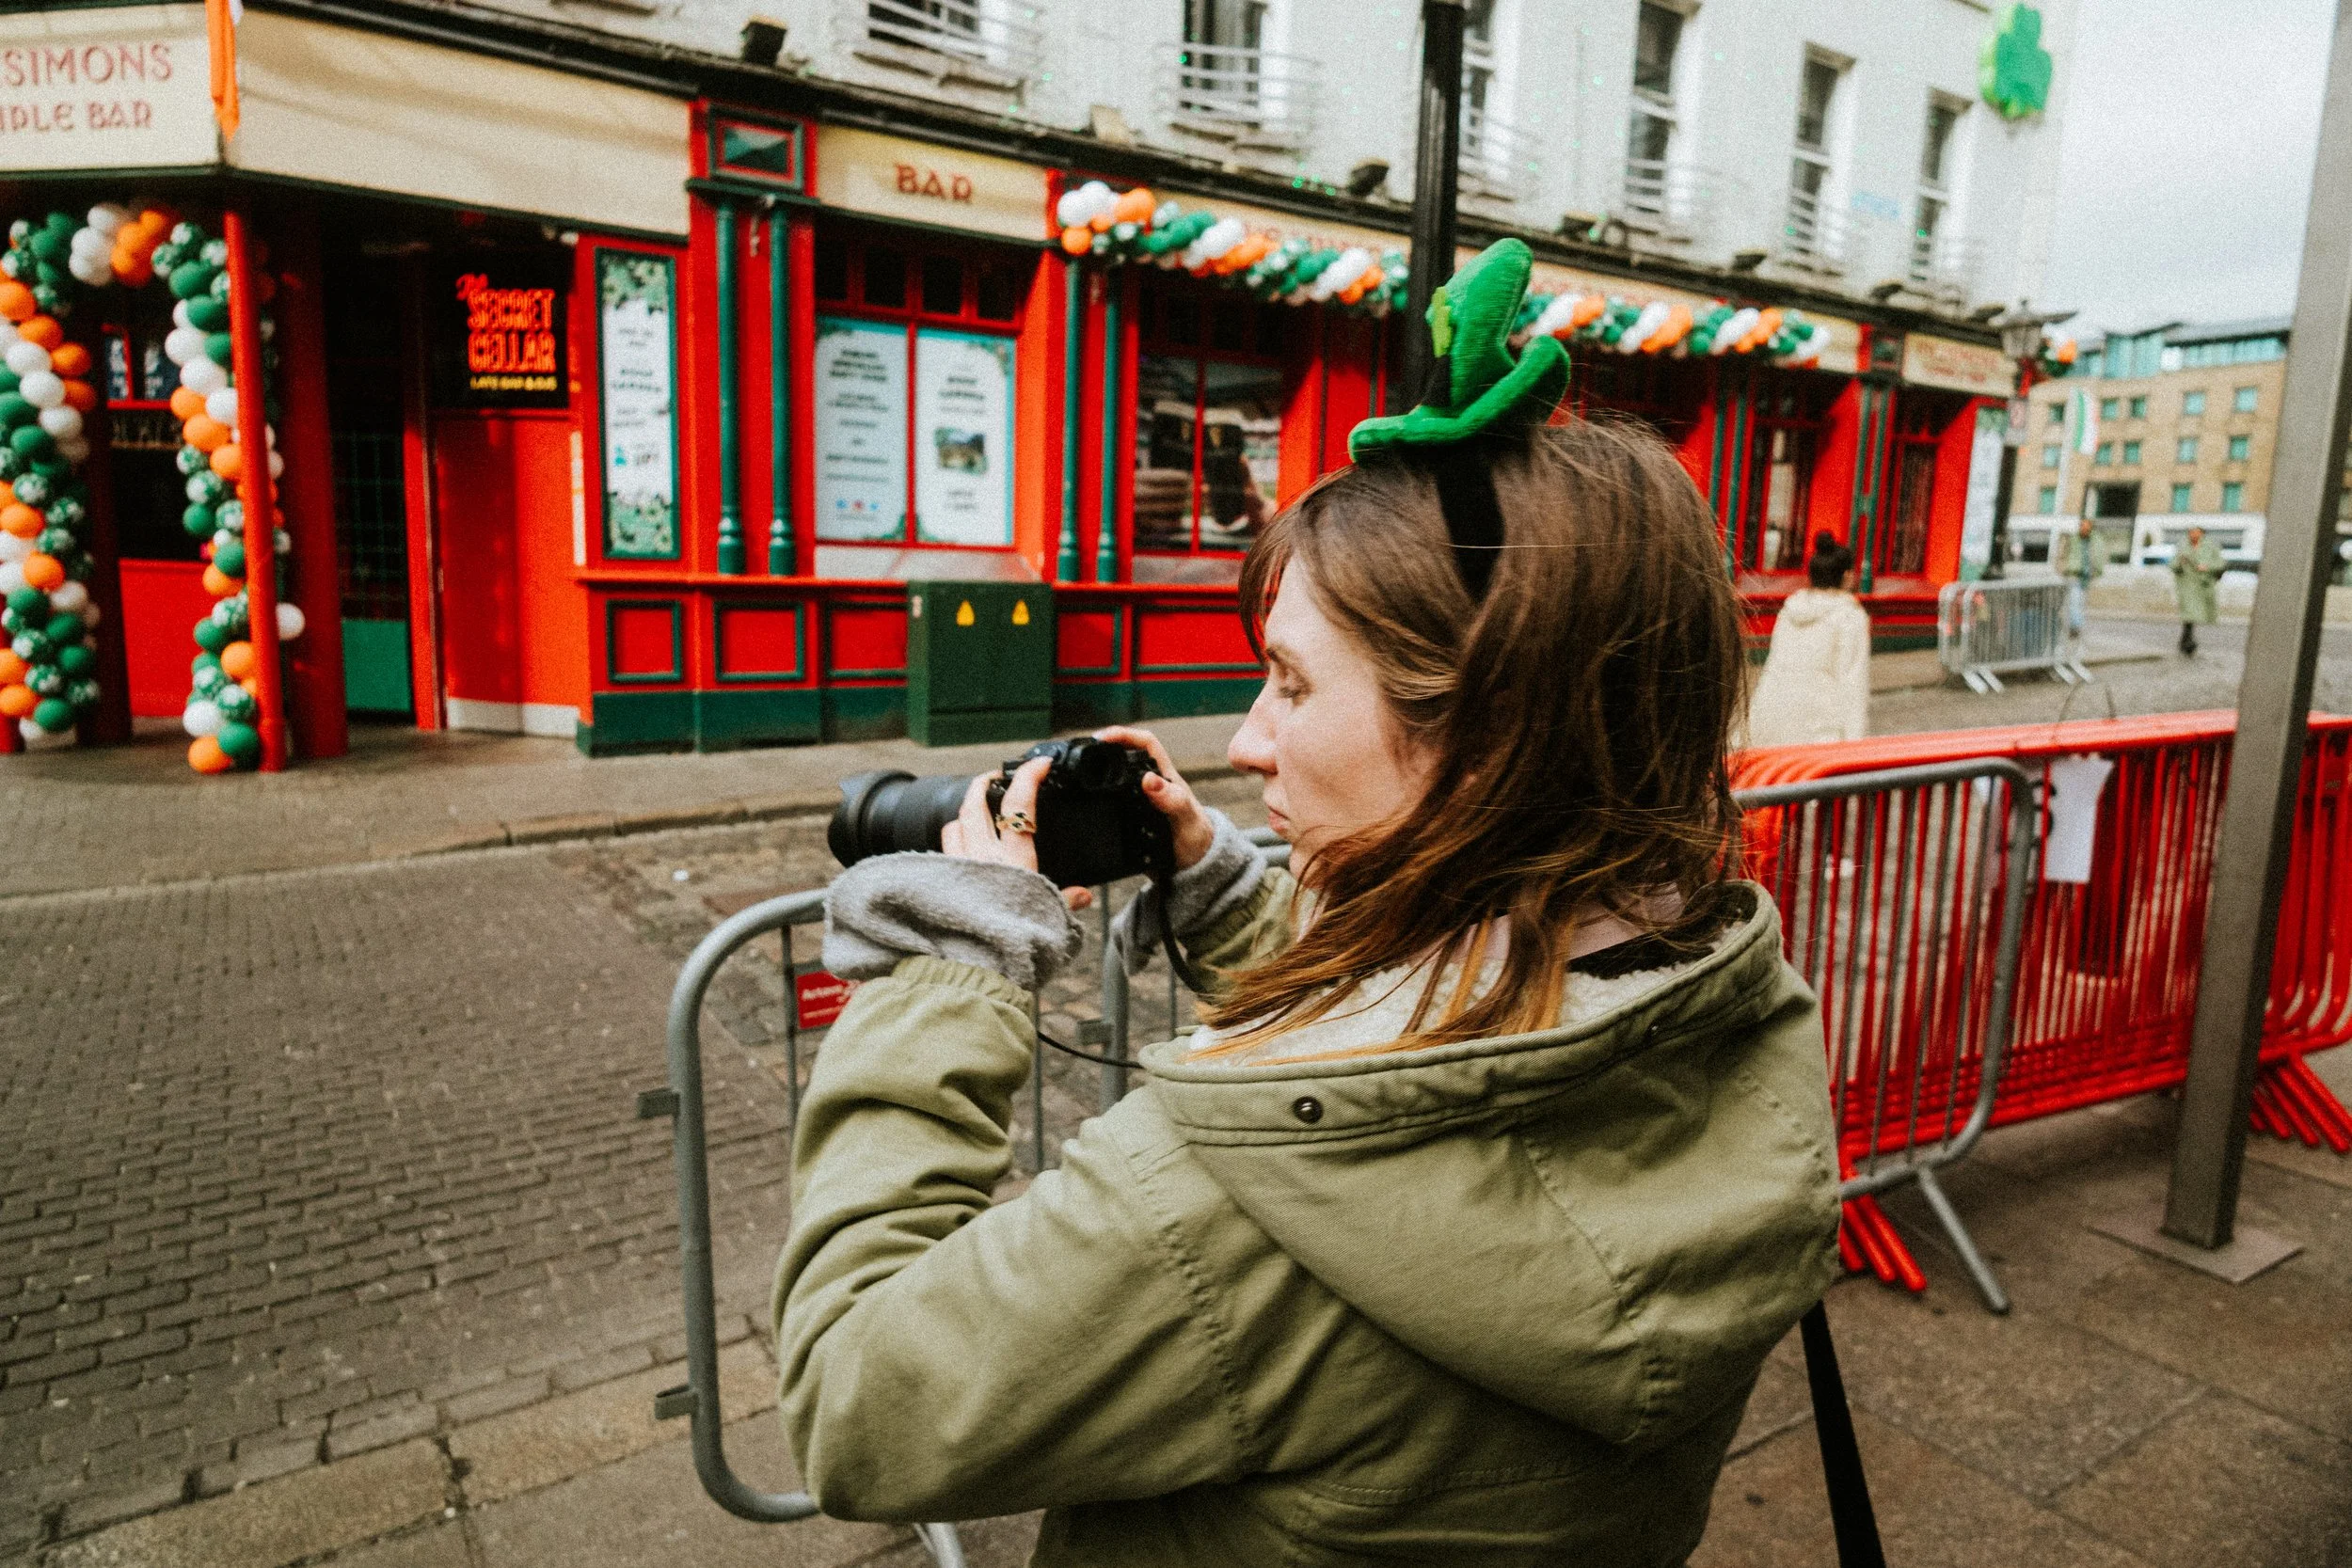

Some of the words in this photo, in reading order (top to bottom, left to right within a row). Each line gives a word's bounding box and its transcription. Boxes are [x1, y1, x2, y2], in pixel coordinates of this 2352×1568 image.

[4, 40, 173, 87] SIMONS
[87, 98, 153, 129] BAR
[895, 163, 973, 202] BAR
[468, 288, 555, 330] SECRET
[469, 331, 556, 373] CELLAR
